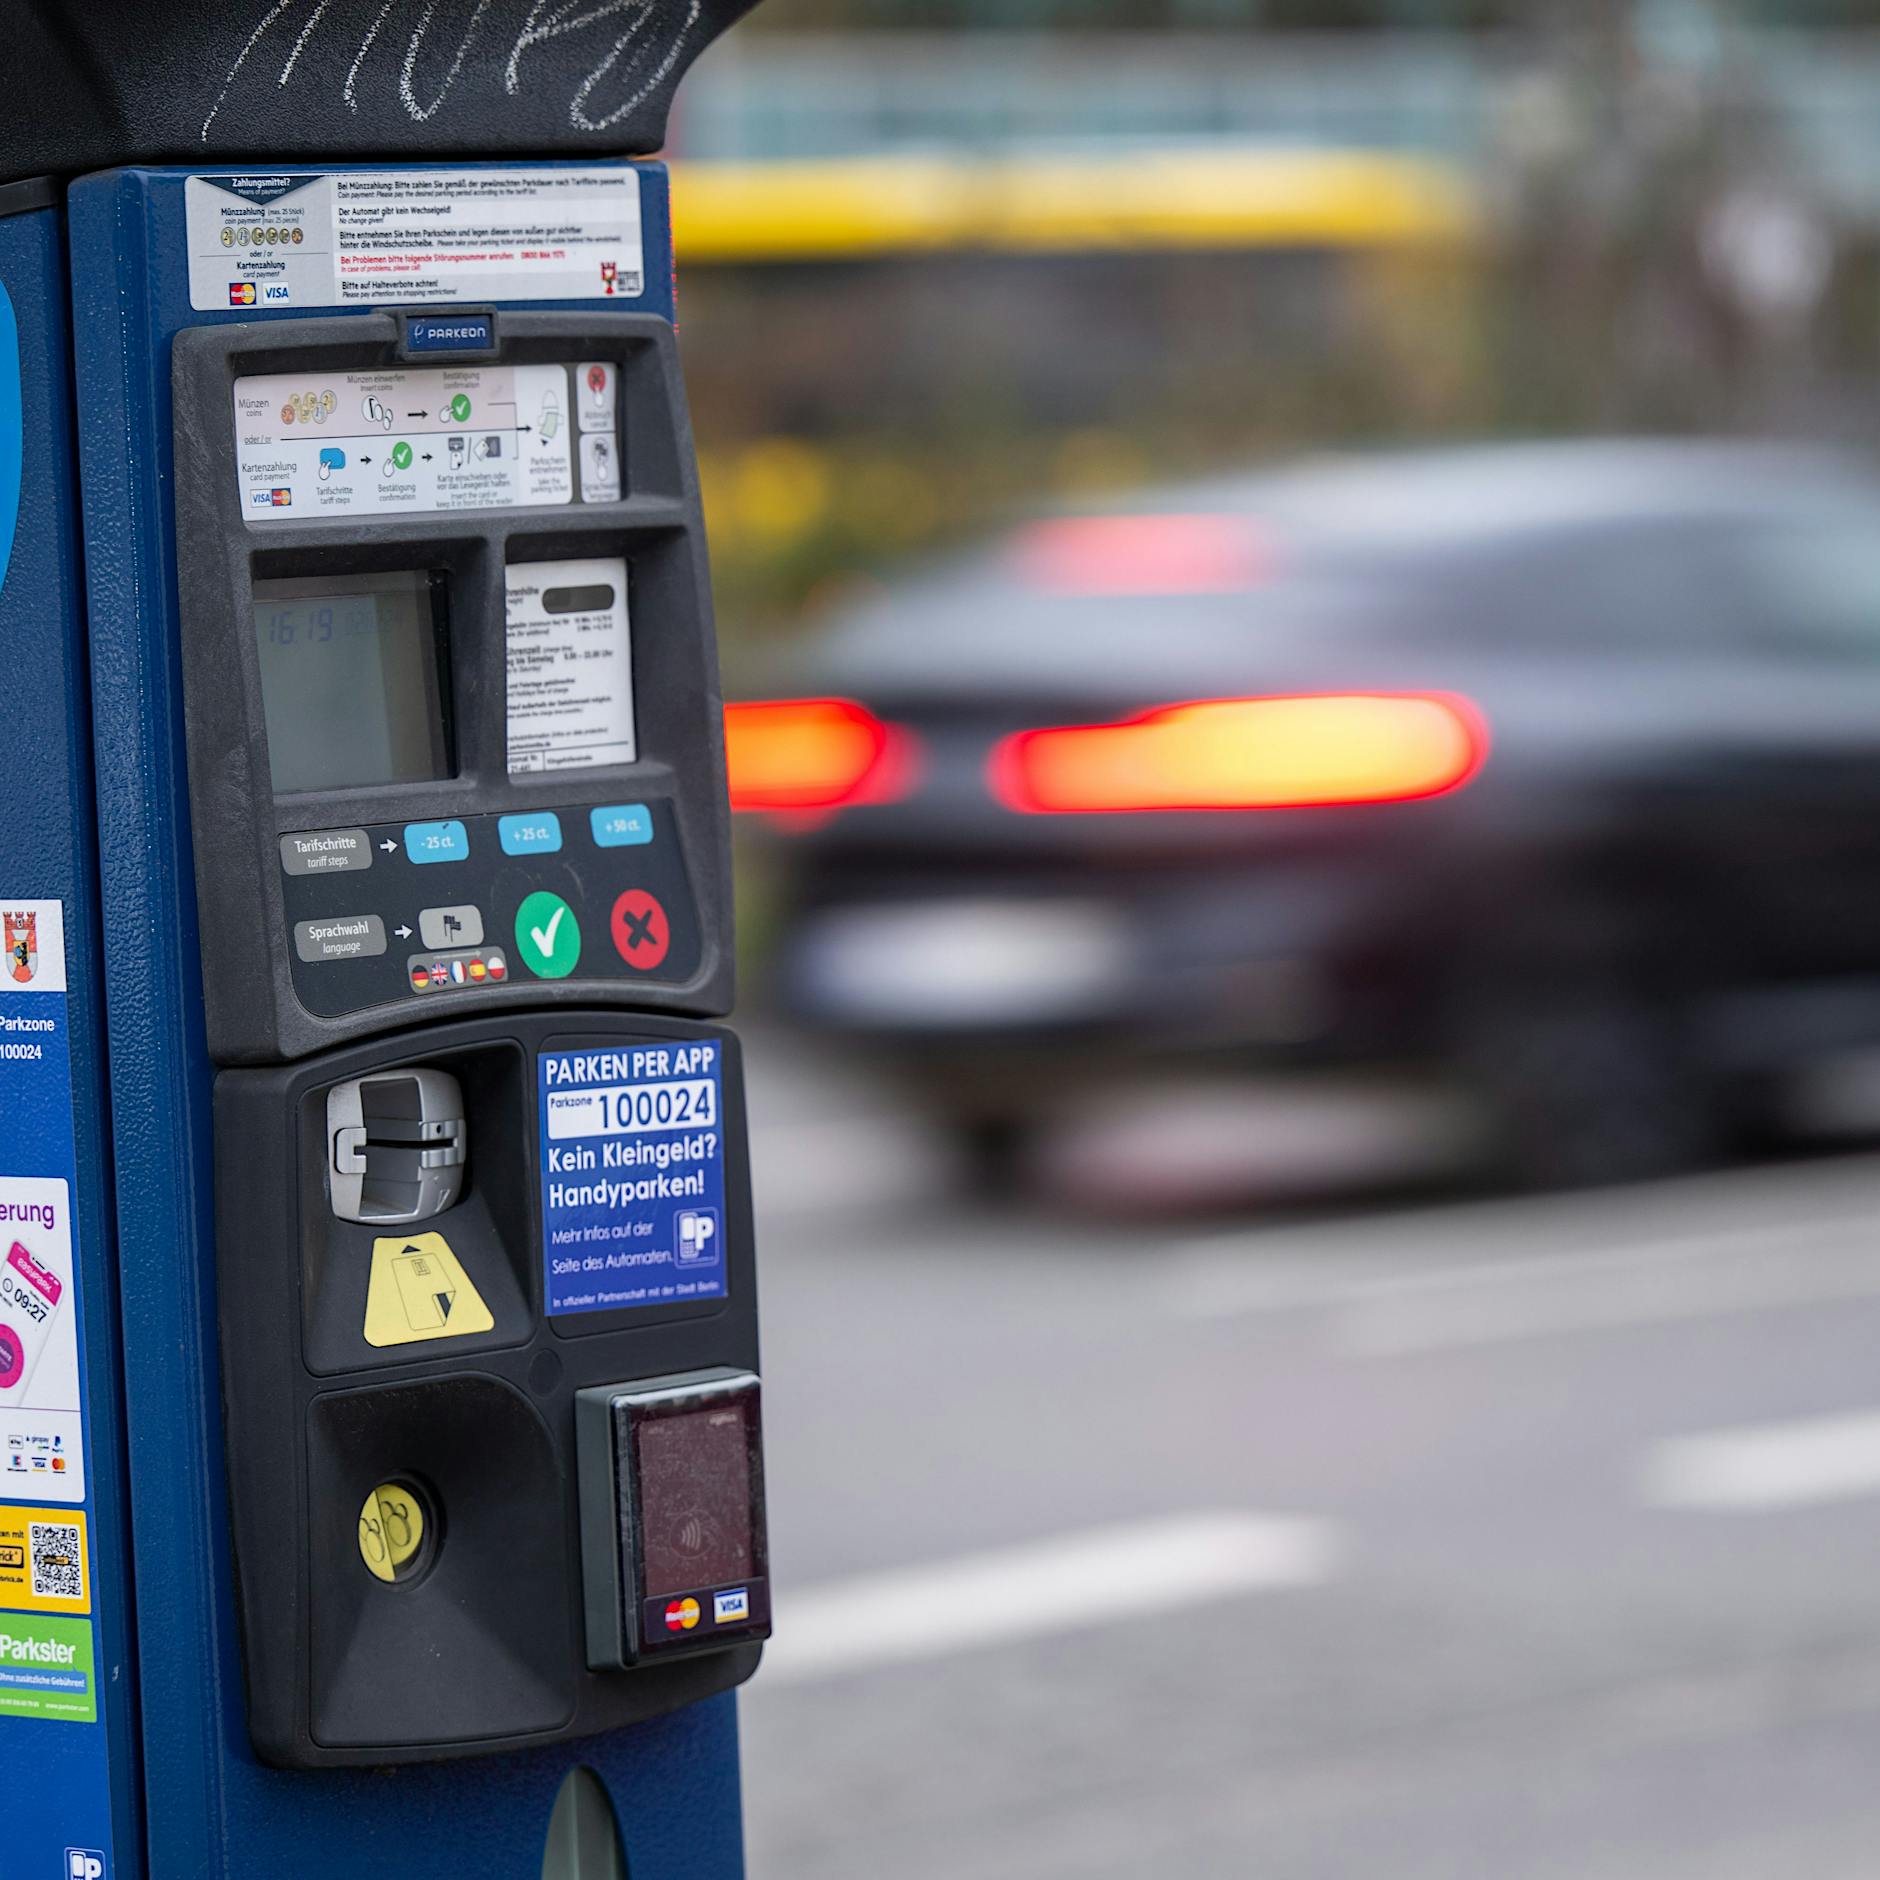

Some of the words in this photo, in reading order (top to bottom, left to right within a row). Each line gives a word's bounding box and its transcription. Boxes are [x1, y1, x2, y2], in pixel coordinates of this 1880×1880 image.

[232, 178, 291, 189] Zahlungsmittel?
[395, 181, 410, 189] Bitte
[445, 179, 466, 189] gemäß
[469, 180, 478, 188] der
[338, 191, 350, 199] Coin
[221, 208, 265, 217] Münzzahlung
[352, 207, 380, 215] Automat
[382, 207, 394, 217] gibt
[396, 207, 409, 215] kein
[348, 217, 367, 225] change
[340, 231, 355, 239] Bitte
[357, 231, 392, 239] entnehmen
[405, 230, 421, 238] Ihren
[423, 229, 456, 237] Parkschein
[458, 229, 470, 237] und
[340, 241, 359, 249] hinter
[341, 256, 351, 264] Bei
[352, 255, 386, 264] Problemen
[405, 254, 432, 263] folgende
[236, 261, 285, 271] Kartenzahlung
[256, 270, 280, 279] payment
[360, 281, 370, 289] auf
[372, 280, 413, 289] Halteverbote
[265, 287, 289, 298] VISA
[428, 327, 486, 339] PARKEON
[238, 399, 269, 409] Münzen
[244, 436, 260, 445] oder
[242, 462, 297, 473] Kartenzahlung
[264, 473, 290, 482] payment
[316, 486, 353, 495] Tarifschritte
[253, 493, 271, 503] VISA
[614, 820, 628, 832] 50
[523, 828, 536, 840] 25
[294, 837, 357, 854] Tarifschritte
[427, 837, 440, 849] 25
[441, 837, 455, 848] ct.
[307, 856, 327, 868] tariff
[328, 856, 348, 869] steps
[308, 921, 369, 940] Sprachwahl
[322, 940, 361, 955] language
[0, 1016, 55, 1031] Parkzone
[0, 1045, 42, 1059] 100024
[545, 1053, 628, 1085] PARKEN
[632, 1050, 670, 1079] PER
[673, 1046, 715, 1075] APP
[550, 1096, 593, 1109] Parkzone
[598, 1085, 710, 1129] 100024
[548, 1145, 596, 1173] Kein
[602, 1132, 717, 1169] Kleingeld?
[549, 1169, 705, 1209] Handyparken!
[0, 1204, 55, 1230] erung
[552, 1229, 581, 1245] Mehr
[583, 1225, 610, 1243] Infos
[611, 1224, 631, 1240] auf
[633, 1221, 653, 1238] der
[552, 1259, 580, 1275] Seite
[583, 1256, 604, 1272] des
[605, 1250, 673, 1270] Automaten.
[553, 1298, 561, 1307] In
[597, 1288, 646, 1303] Partnerschaft
[648, 1286, 660, 1297] mit
[661, 1285, 675, 1296] der
[676, 1283, 695, 1294] Stadt
[14, 1289, 47, 1323] 09:27
[720, 1598, 744, 1612] VISA
[0, 1634, 76, 1663] Parkster
